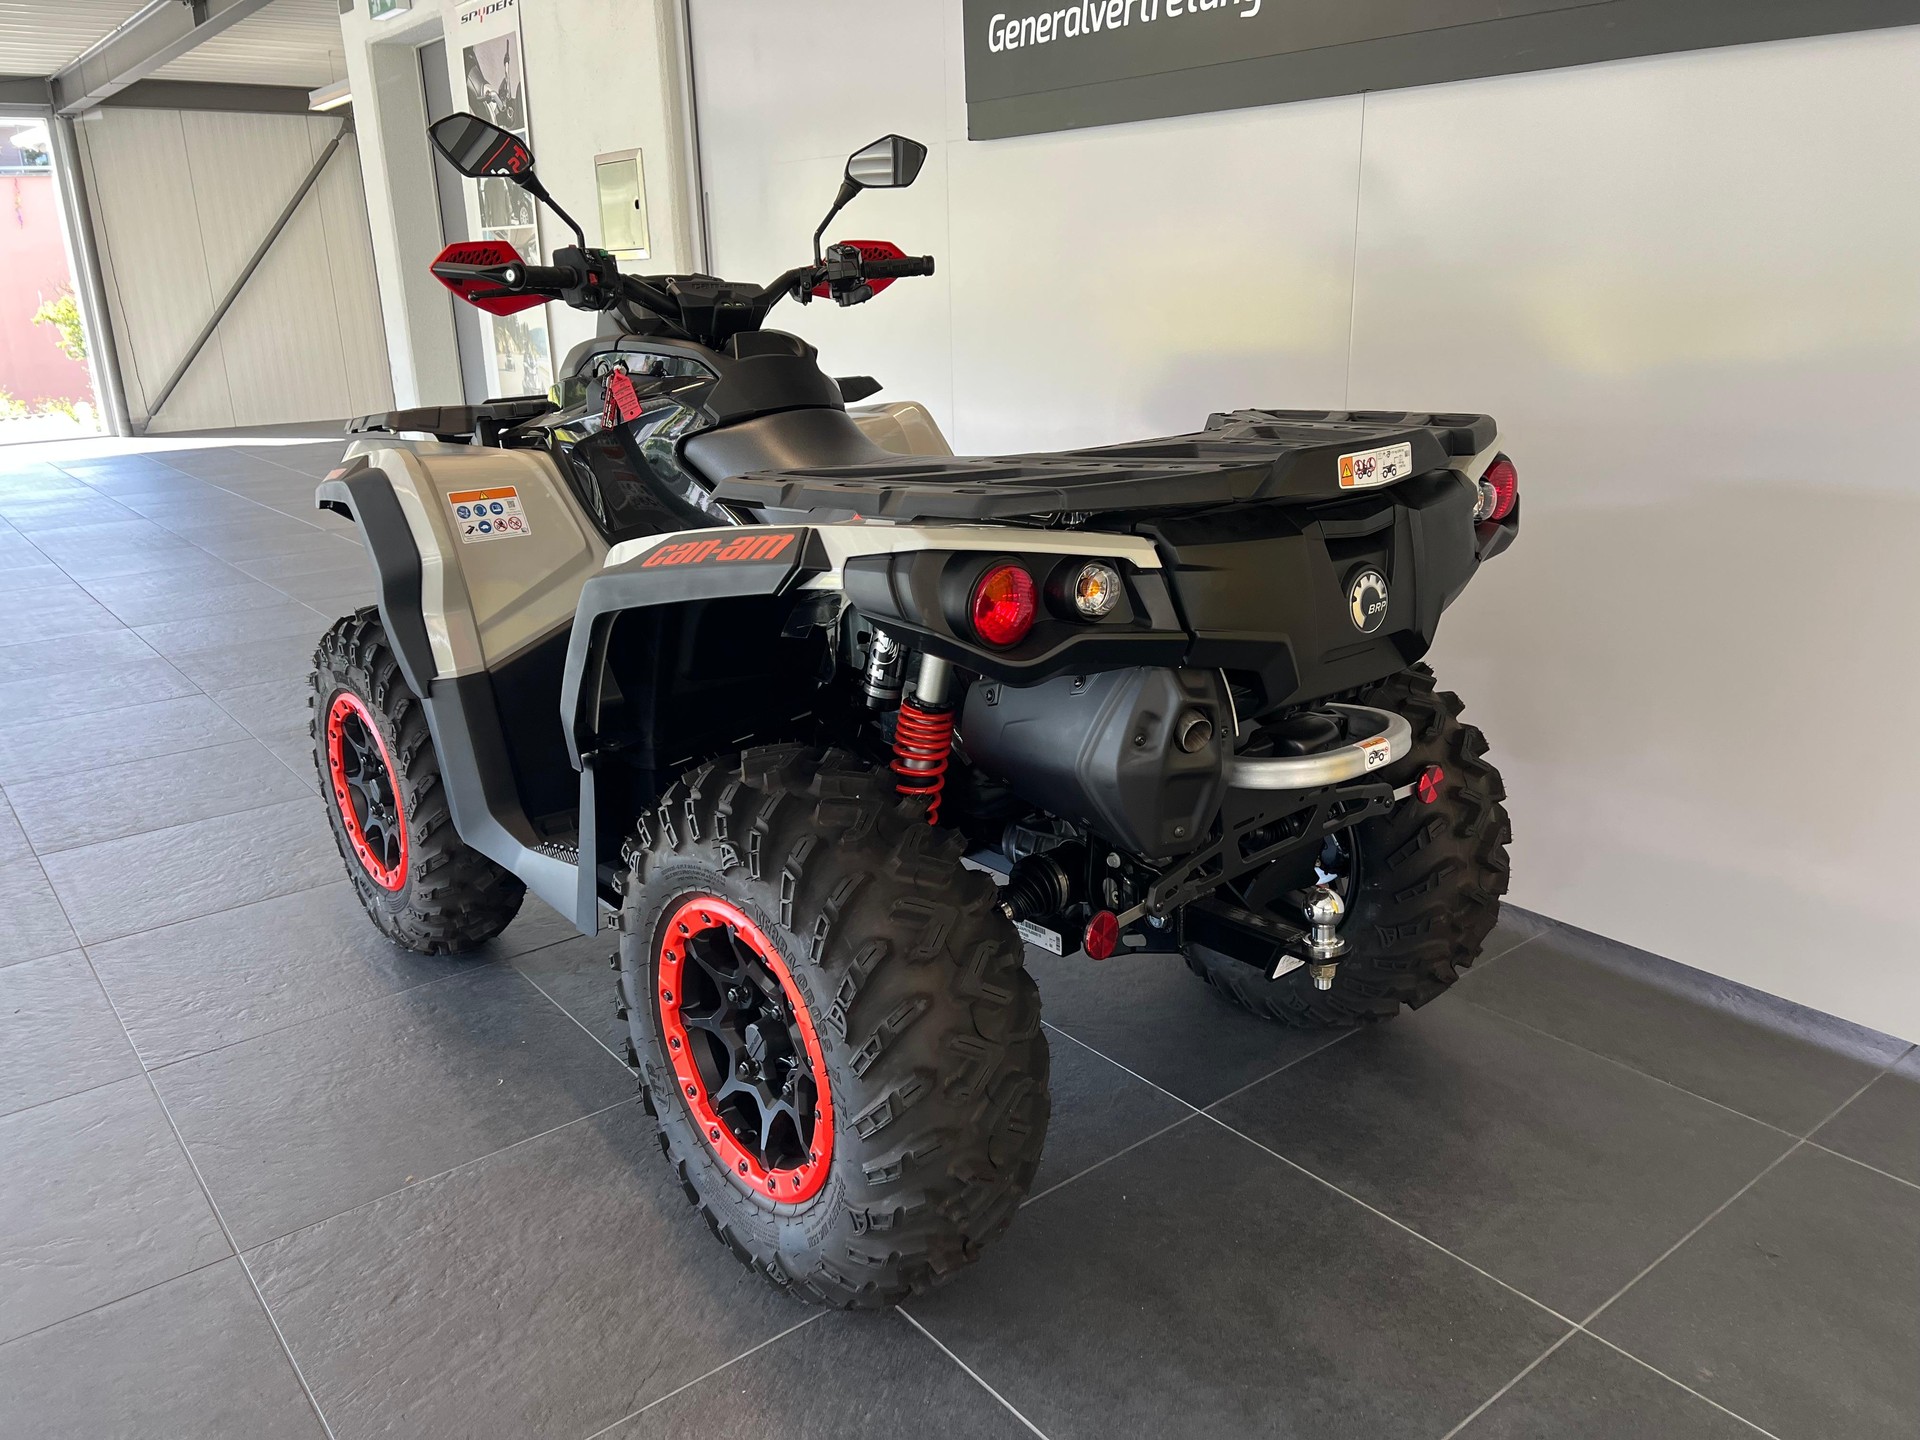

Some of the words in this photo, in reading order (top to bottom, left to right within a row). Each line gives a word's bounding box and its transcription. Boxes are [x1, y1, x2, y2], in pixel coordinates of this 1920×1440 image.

[461, 0, 513, 24] SPYDER
[988, 0, 1260, 53] Generalvertre
[641, 533, 795, 568] can-am
[1368, 600, 1387, 614] BRP
